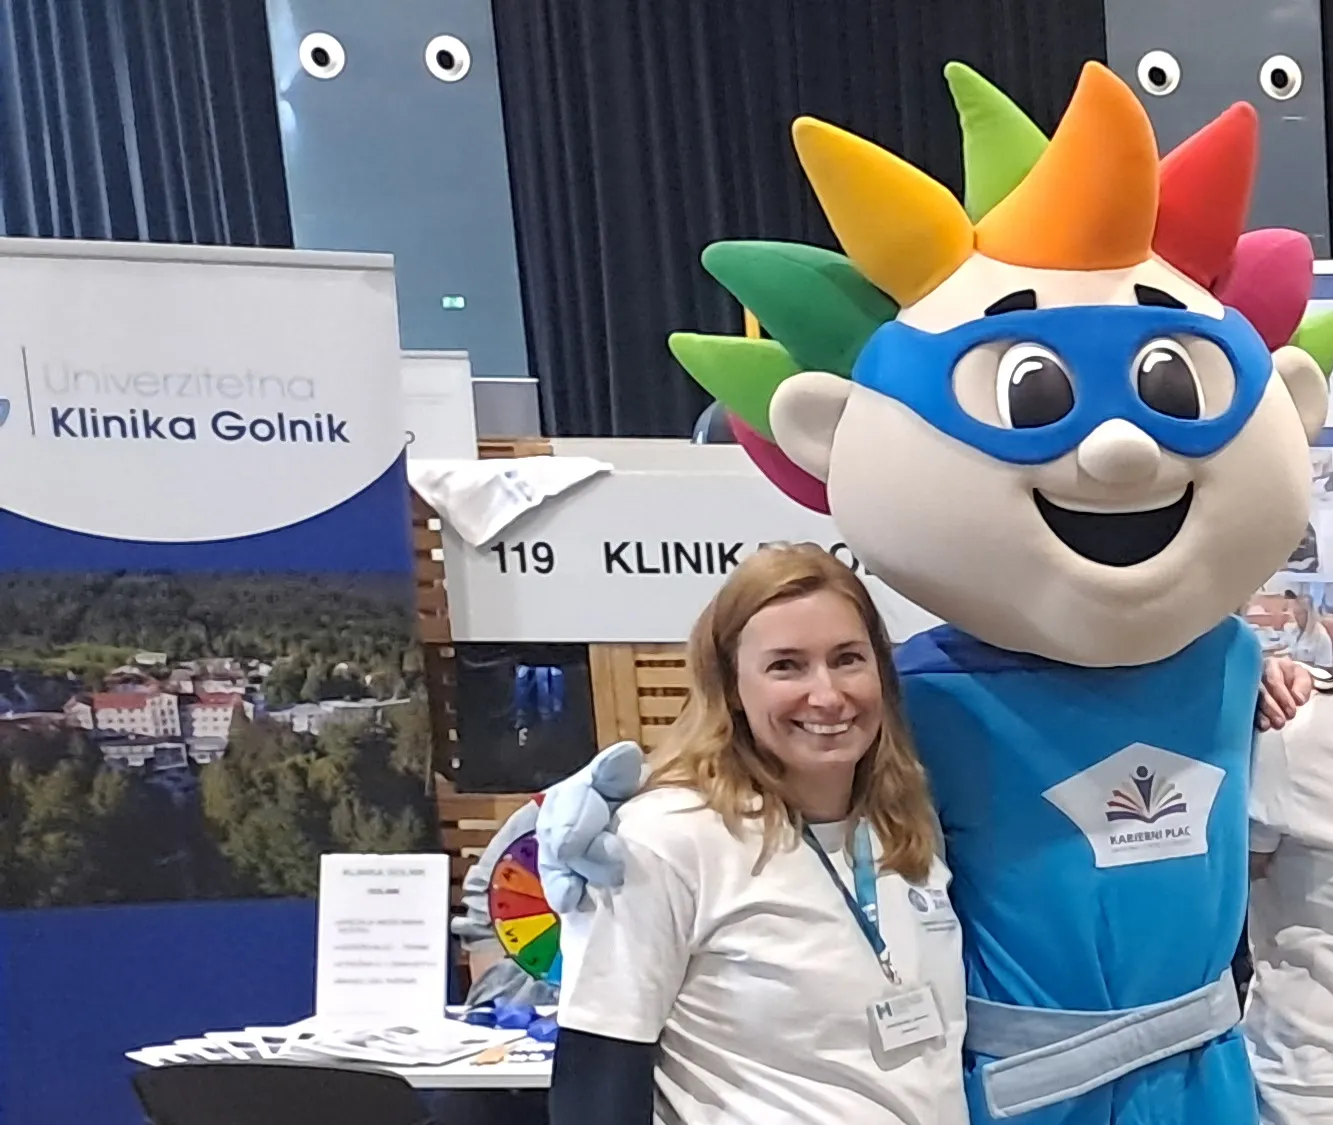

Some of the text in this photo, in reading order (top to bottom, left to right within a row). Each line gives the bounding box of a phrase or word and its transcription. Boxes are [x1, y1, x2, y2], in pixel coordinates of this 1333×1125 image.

[44, 365, 316, 400] Univerzitetna
[51, 406, 350, 443] Klinika Golnik
[491, 541, 555, 574] 119
[604, 541, 767, 575] KLINIK
